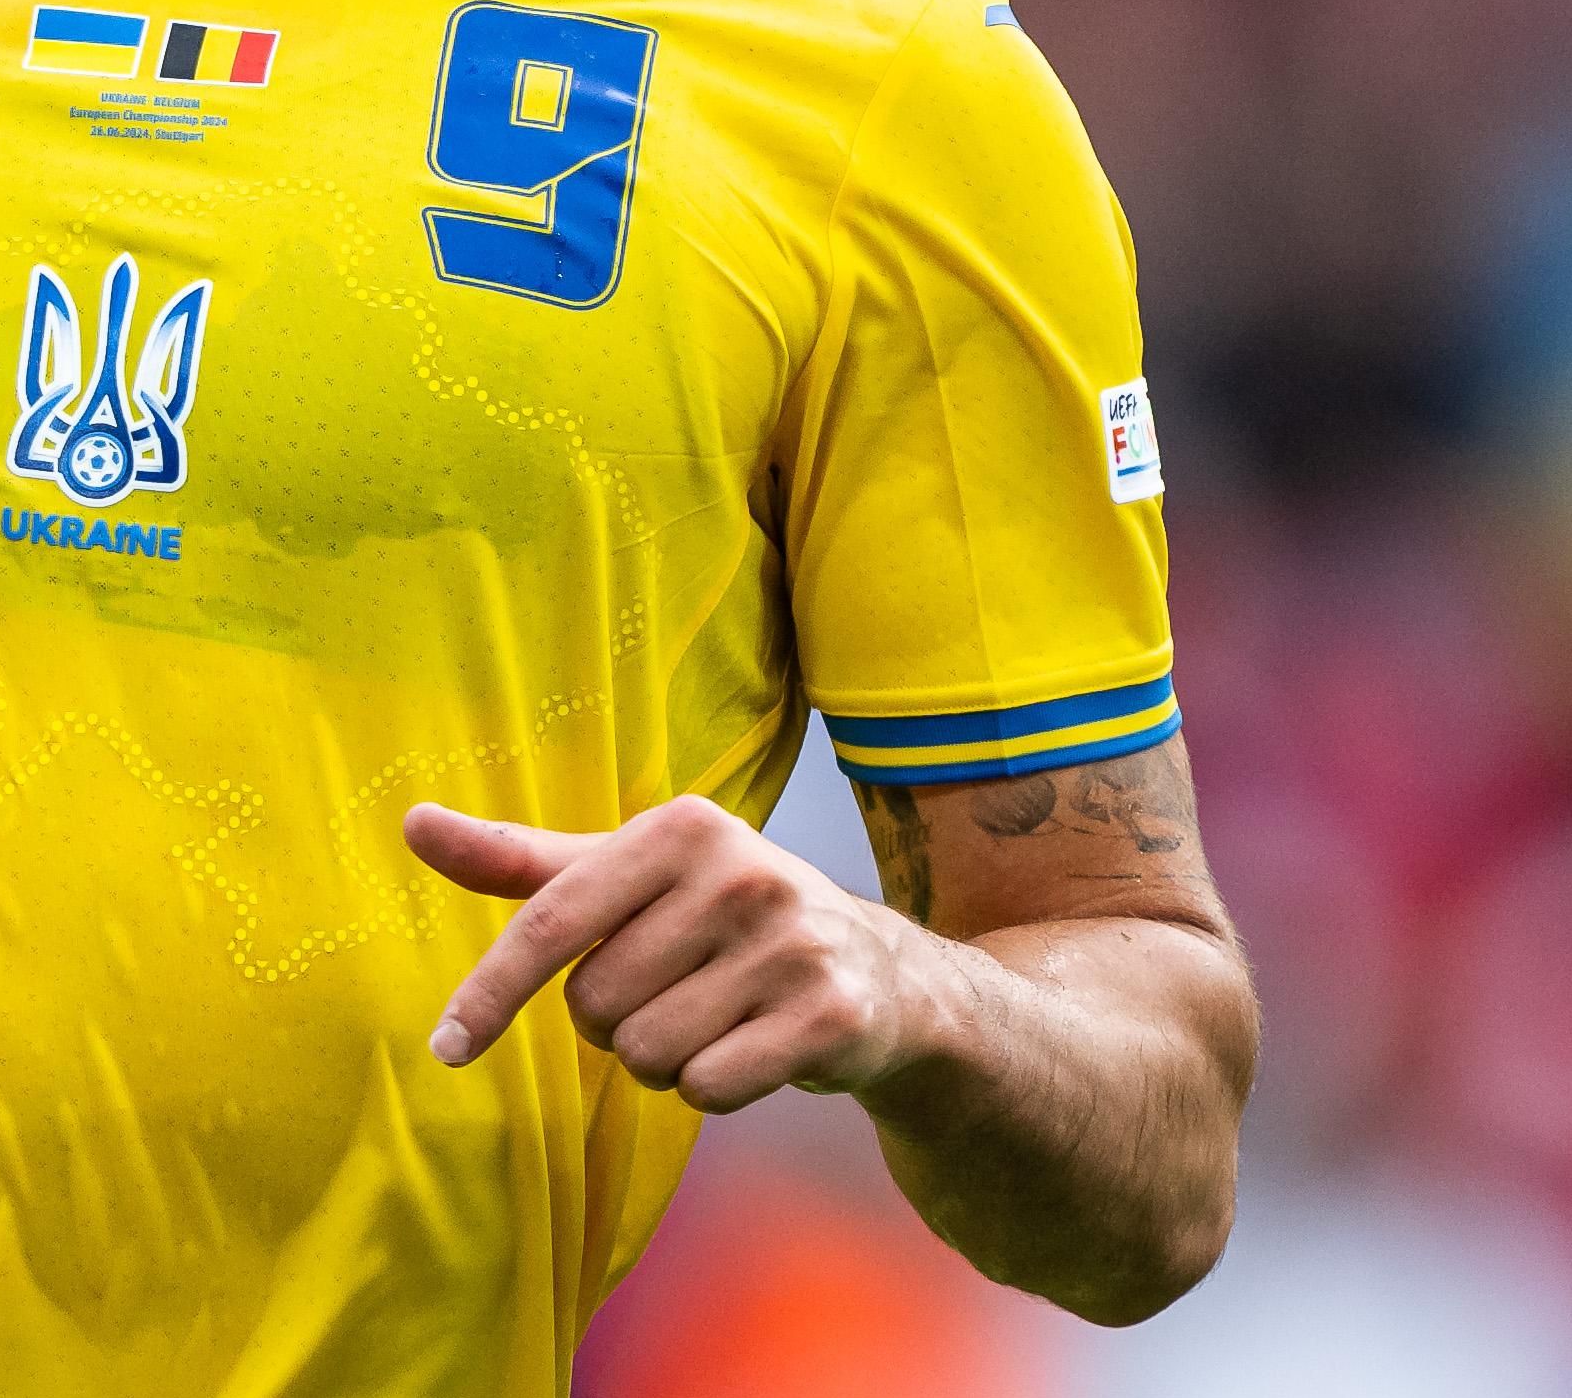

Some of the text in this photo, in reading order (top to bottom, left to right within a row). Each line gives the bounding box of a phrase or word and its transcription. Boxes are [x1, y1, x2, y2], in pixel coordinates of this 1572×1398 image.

[69, 106, 228, 127] European Championship 2024
[155, 128, 204, 143] Stuttgart
[421, 0, 659, 312] 9
[0, 506, 183, 561] UKRAINE
